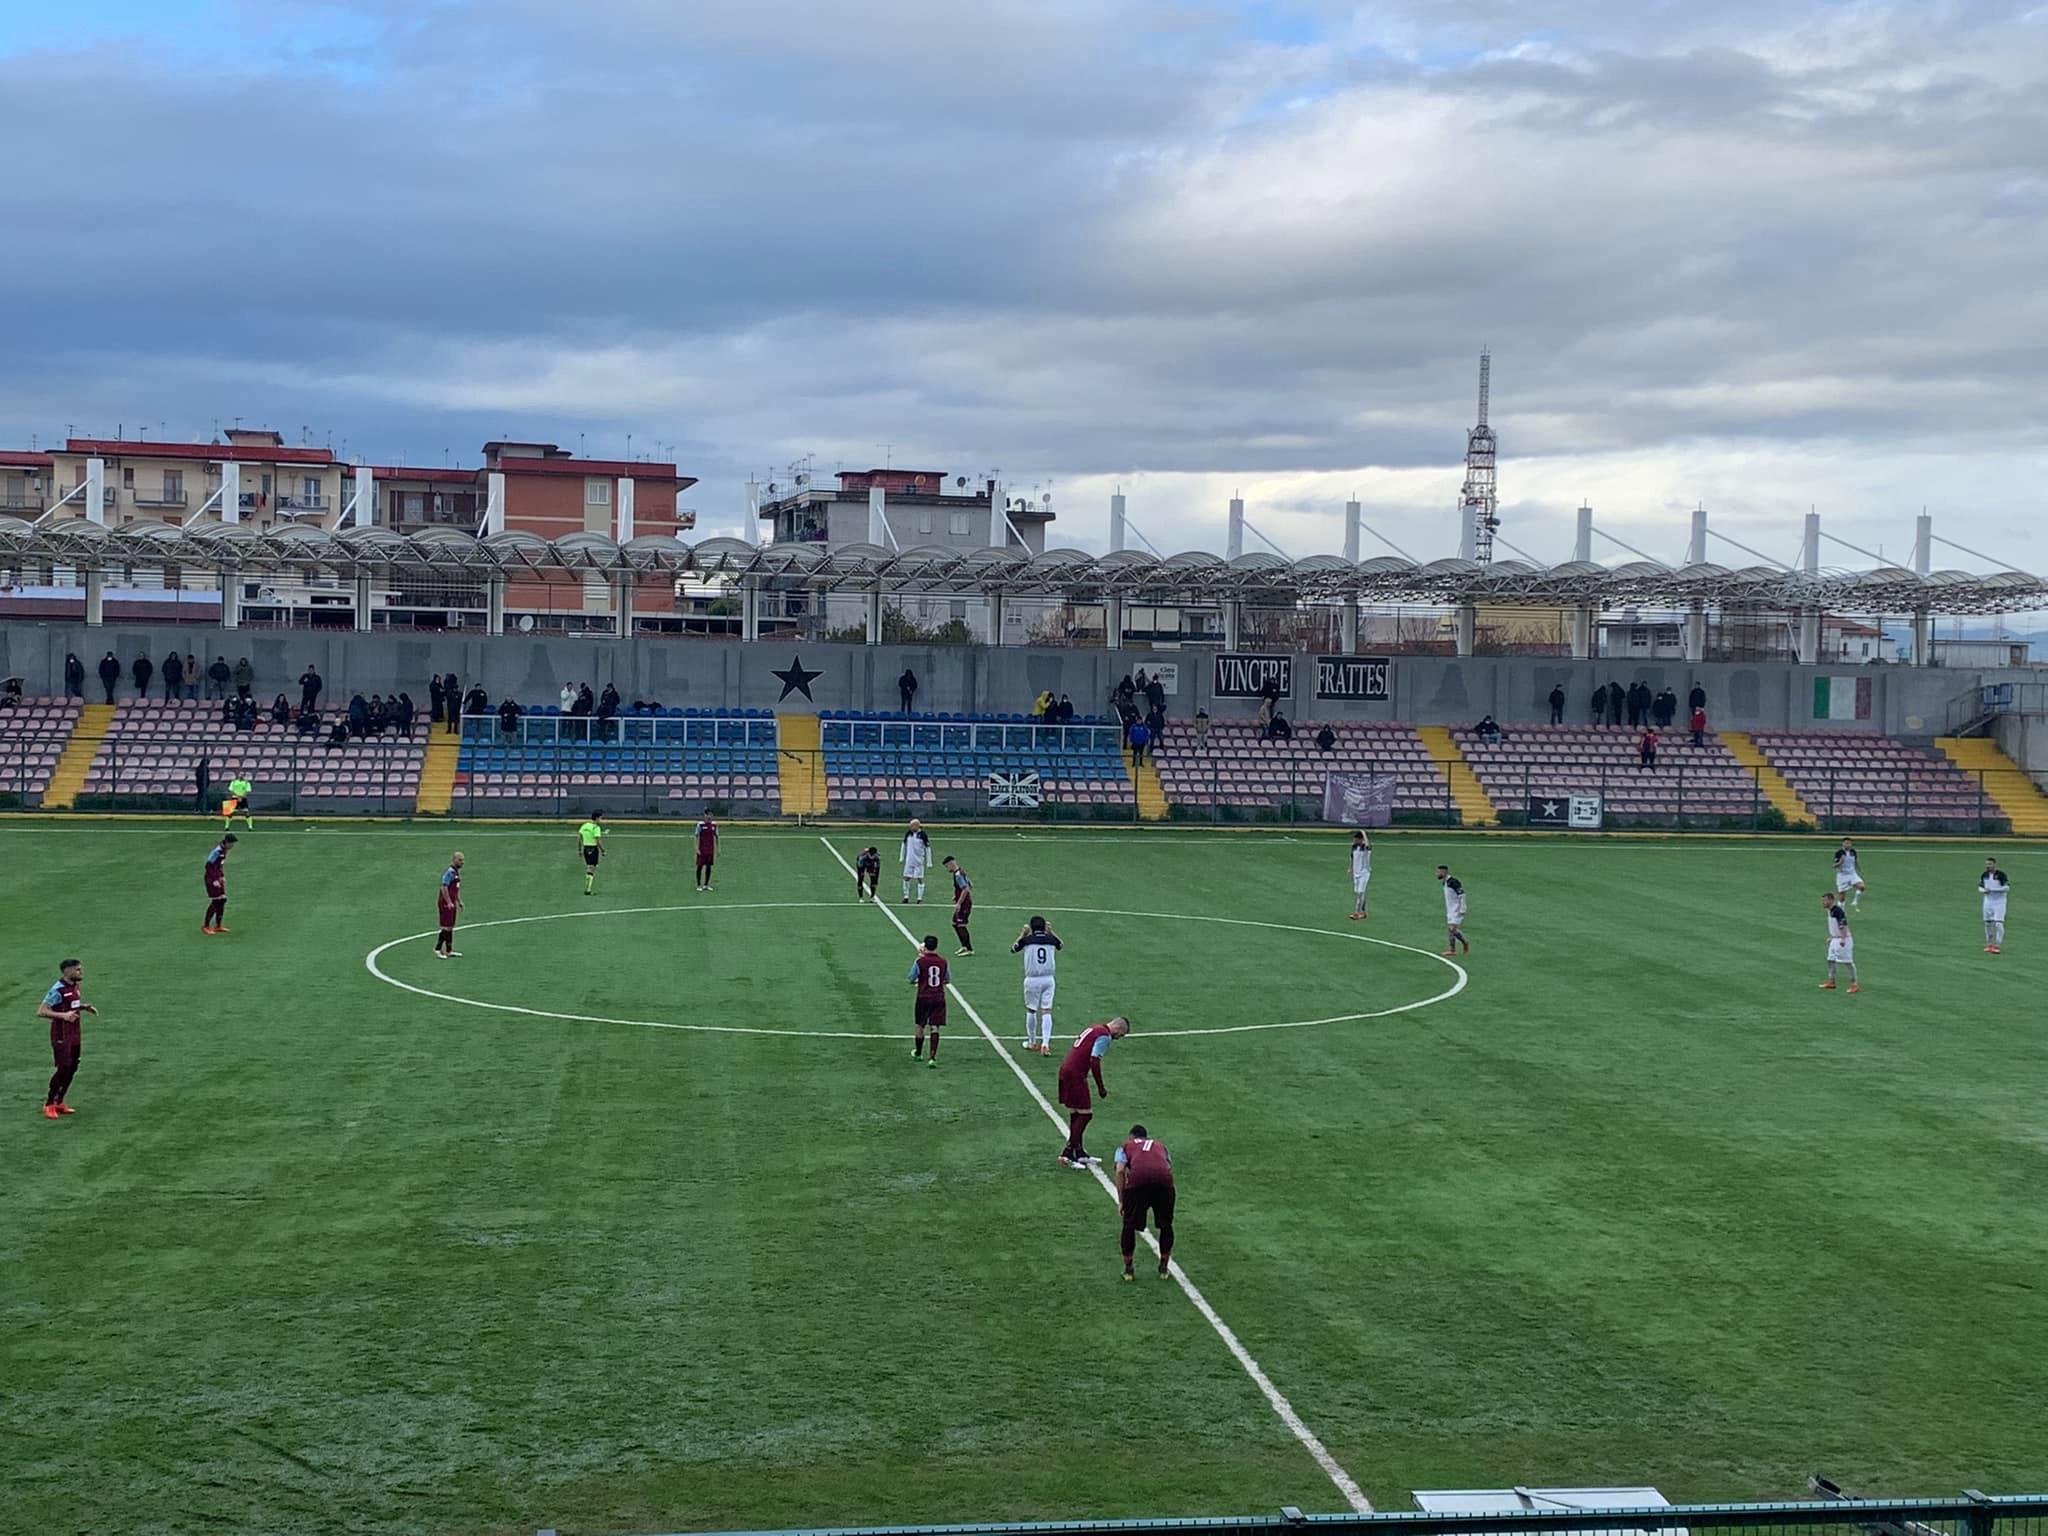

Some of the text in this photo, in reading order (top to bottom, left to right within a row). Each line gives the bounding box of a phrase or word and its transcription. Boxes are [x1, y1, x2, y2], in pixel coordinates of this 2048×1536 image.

[1218, 659, 1289, 692] VINCERE
[1316, 663, 1390, 695] FRATTESI
[1036, 947, 1047, 964] 9
[928, 965, 941, 988] 8
